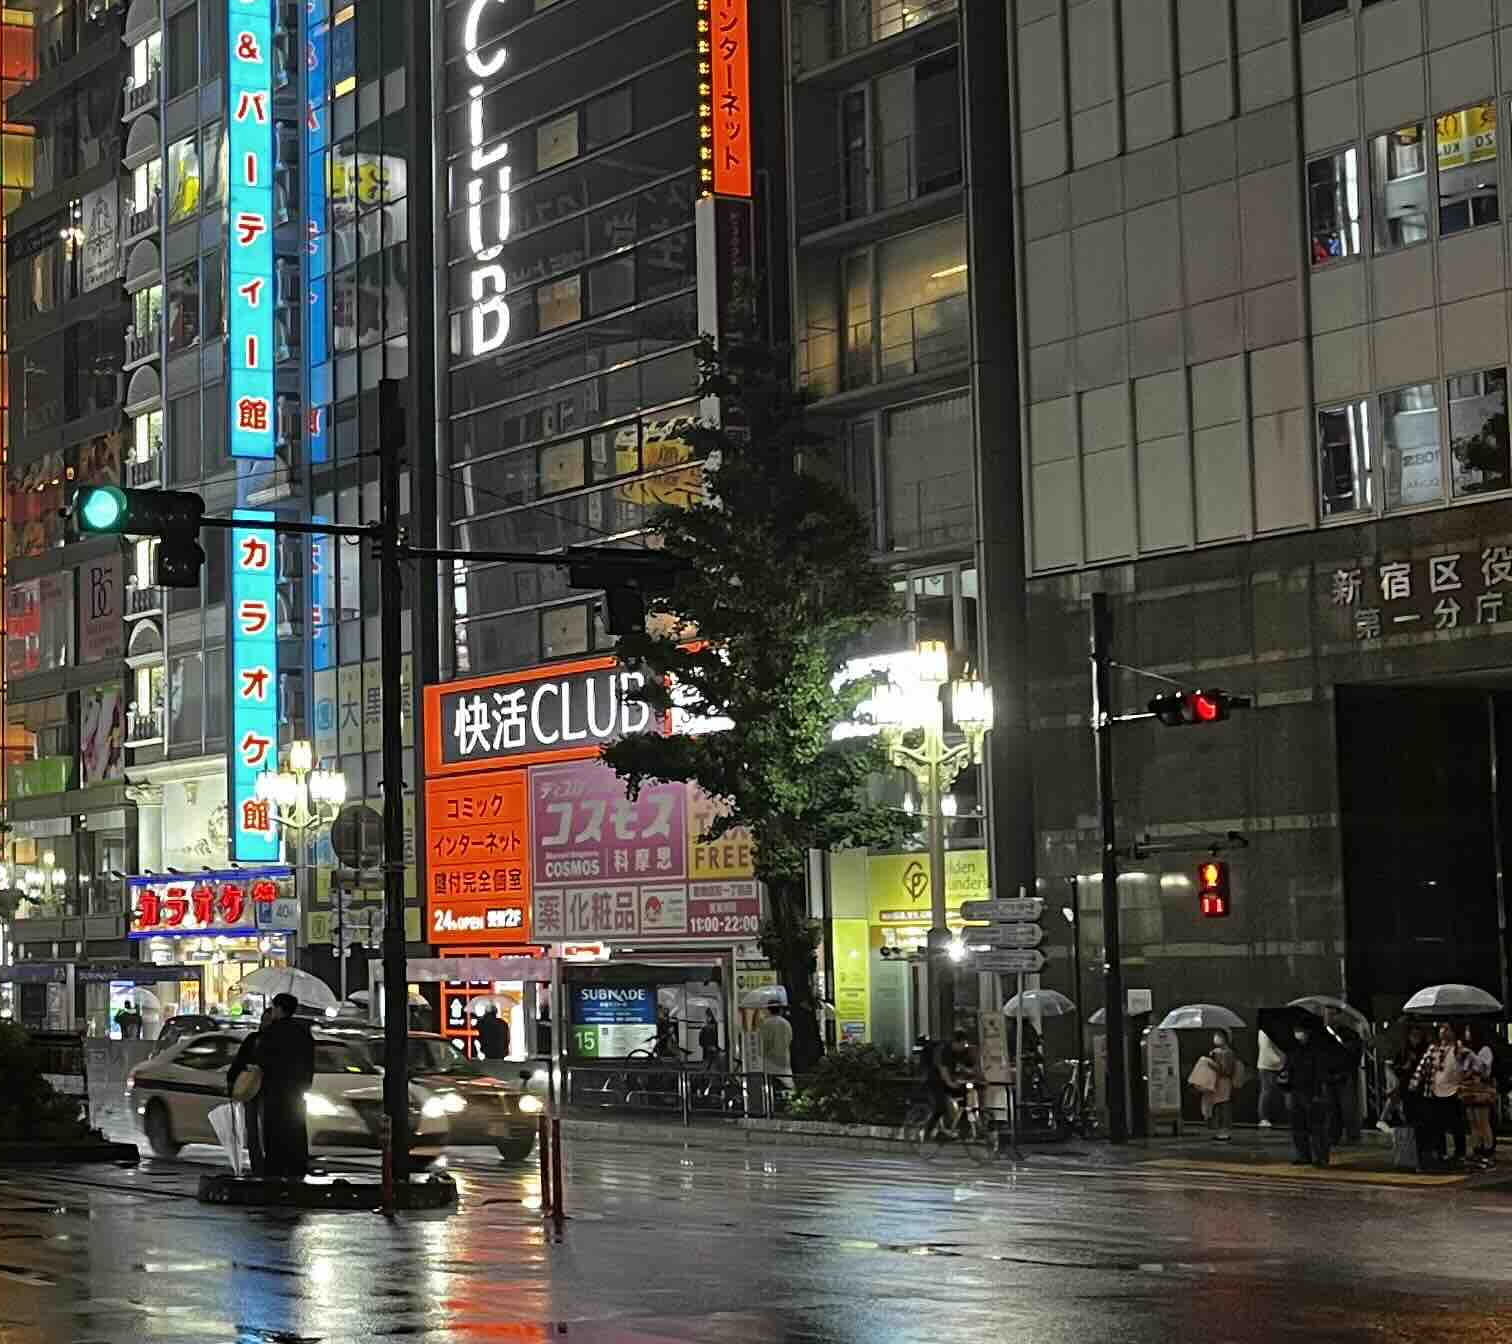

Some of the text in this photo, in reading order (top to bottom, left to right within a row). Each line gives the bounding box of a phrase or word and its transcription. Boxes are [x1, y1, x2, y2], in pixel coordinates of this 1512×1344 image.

[1331, 546, 1512, 606] 新宿区役
[1354, 592, 1504, 640] 第一分庁
[240, 537, 272, 834] カラオケ館
[454, 668, 650, 755] 快活CLUB
[446, 793, 503, 820] コミック
[541, 793, 676, 848] コスモス
[433, 829, 521, 857] インターネット
[694, 843, 750, 871] FREE
[545, 859, 601, 879] COSMOS
[538, 894, 561, 933] 薬
